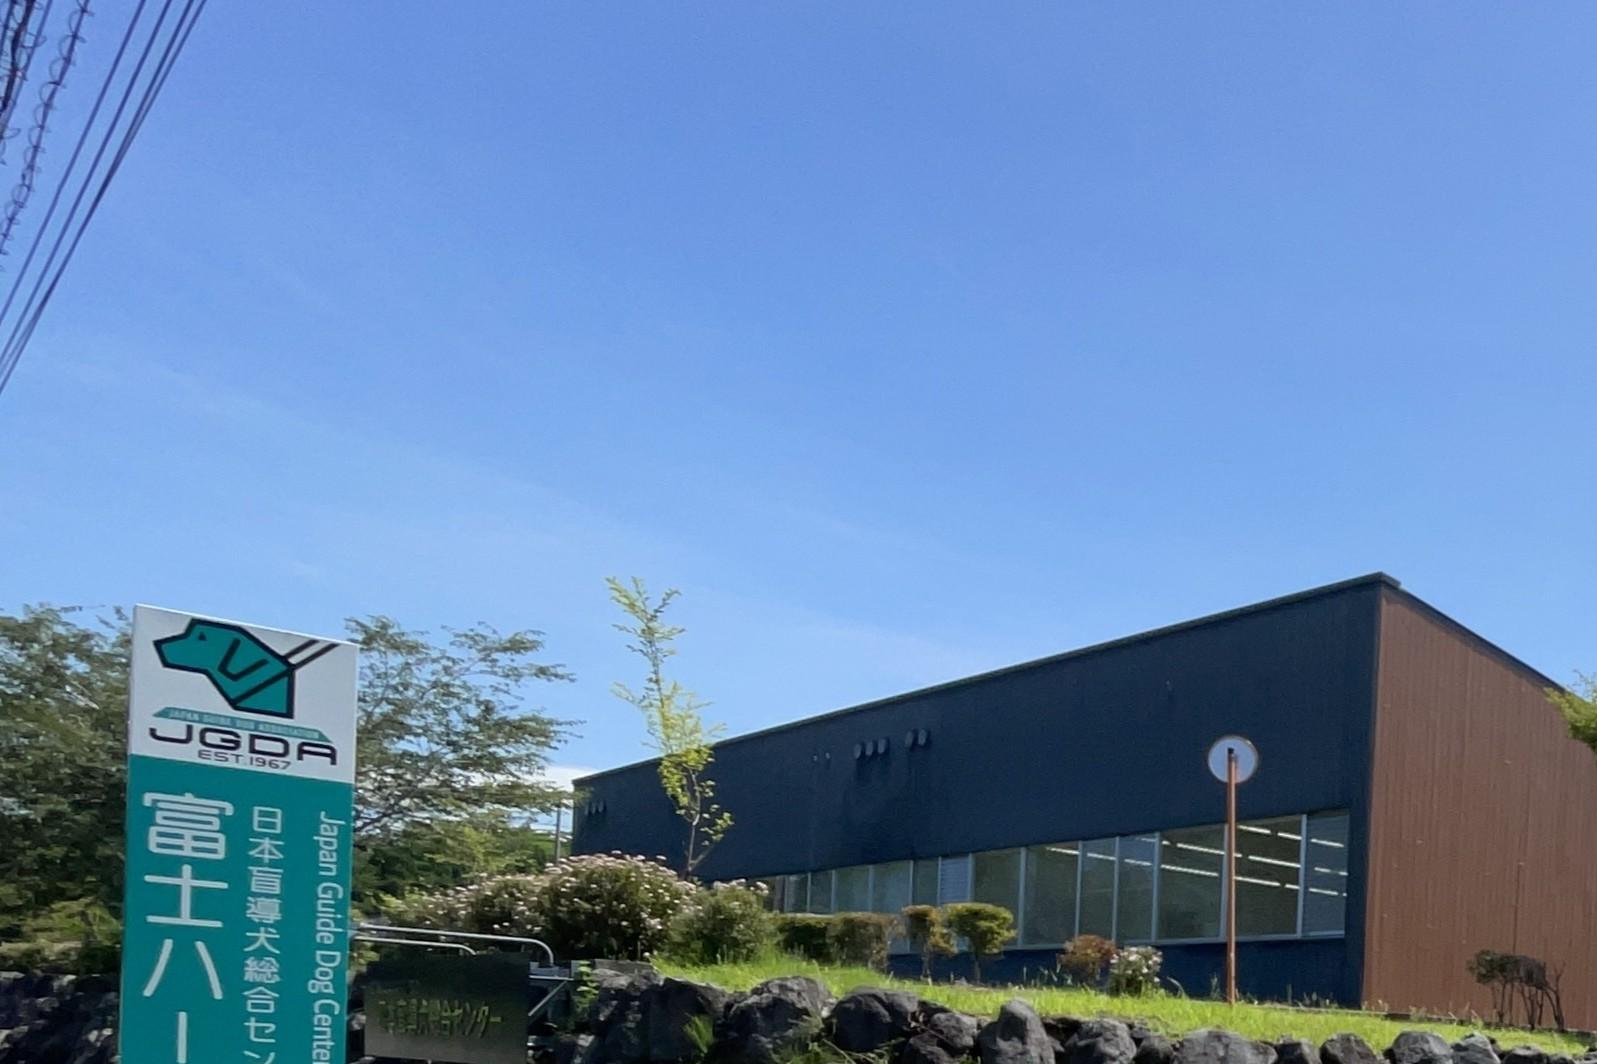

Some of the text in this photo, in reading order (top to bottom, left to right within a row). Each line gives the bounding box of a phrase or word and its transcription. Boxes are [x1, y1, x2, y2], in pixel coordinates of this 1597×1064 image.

[149, 724, 337, 765] JGDA
[198, 749, 291, 770] EST.1967
[313, 811, 346, 876] Japan
[316, 882, 343, 944] Guide
[307, 950, 341, 994] Dog
